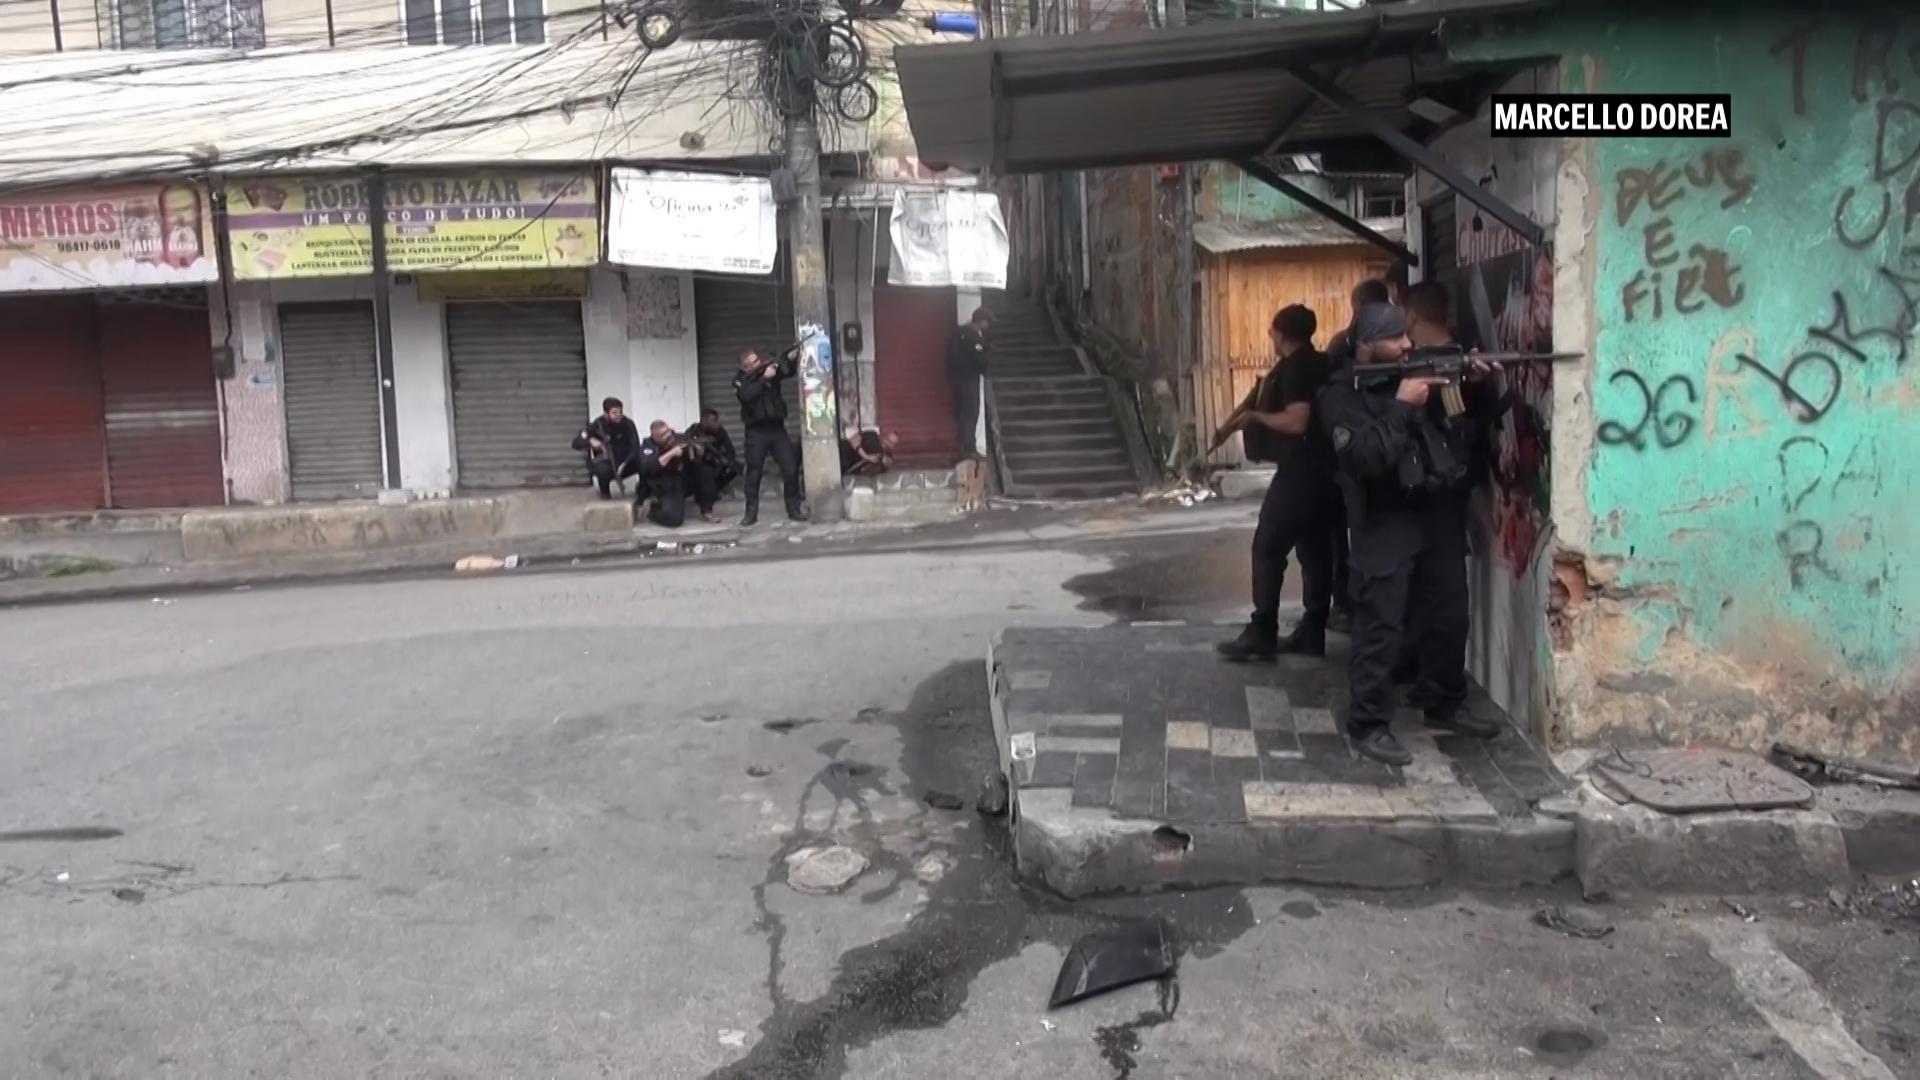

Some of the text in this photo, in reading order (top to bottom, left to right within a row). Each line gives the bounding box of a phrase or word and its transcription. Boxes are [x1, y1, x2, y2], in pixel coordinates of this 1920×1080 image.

[432, 176, 521, 206] BAZAR
[303, 206, 525, 226] UM POCO DE TUDO!
